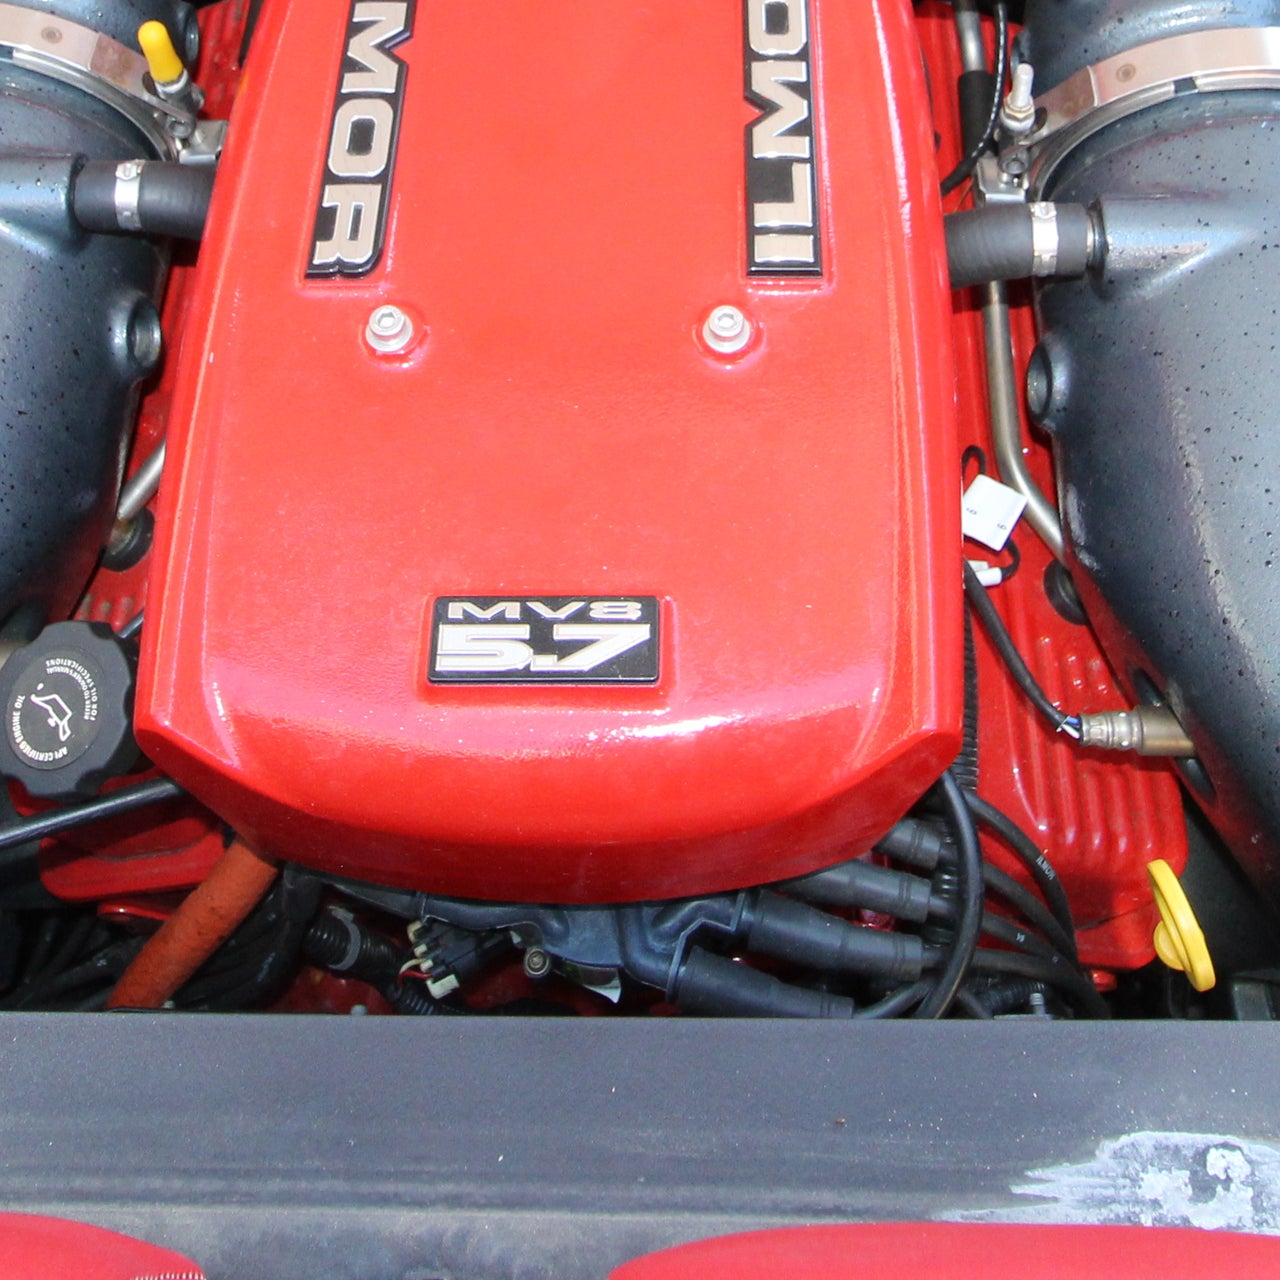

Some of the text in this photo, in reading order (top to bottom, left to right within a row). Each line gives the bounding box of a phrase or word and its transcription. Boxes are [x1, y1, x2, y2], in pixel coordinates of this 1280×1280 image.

[448, 600, 642, 620] MV8
[435, 623, 652, 672] 5.7
[46, 658, 100, 720] FOR OIL SPECIFICATIONS
[12, 694, 68, 762] API CERTIFIED ENGINE OIL
